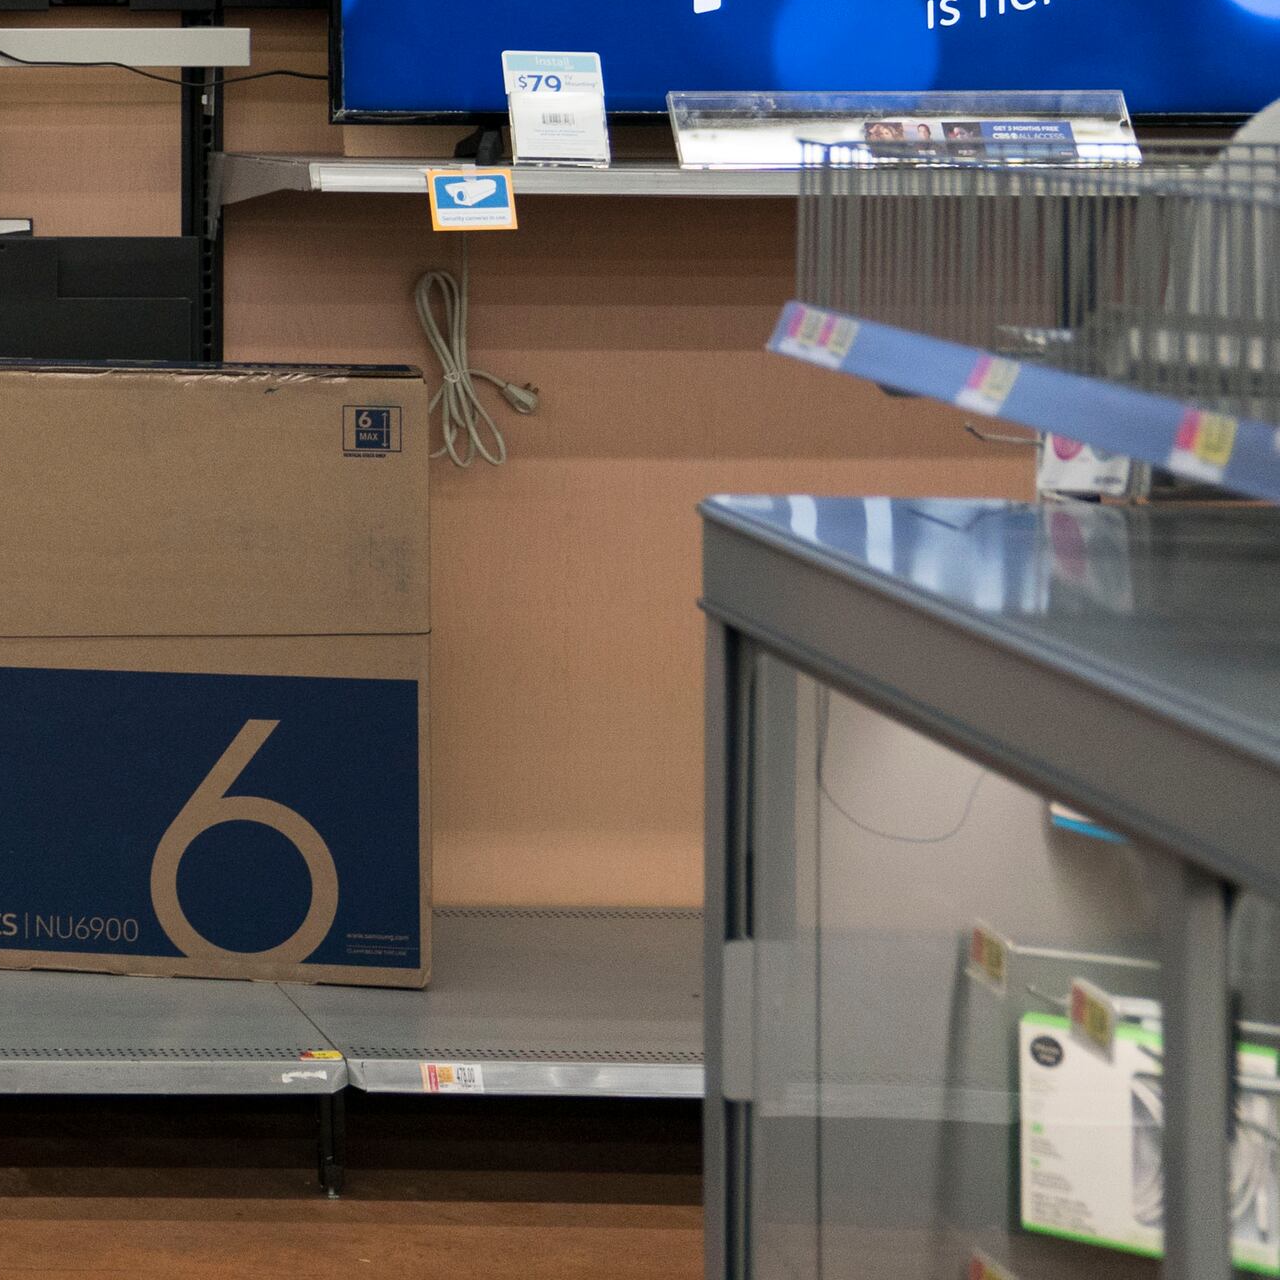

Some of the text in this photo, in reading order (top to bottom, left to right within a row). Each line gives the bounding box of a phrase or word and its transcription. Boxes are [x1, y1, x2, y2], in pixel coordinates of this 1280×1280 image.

[518, 74, 562, 92] $79
[358, 411, 372, 428] 6
[149, 718, 339, 964] 6
[35, 915, 139, 942] NU6900
